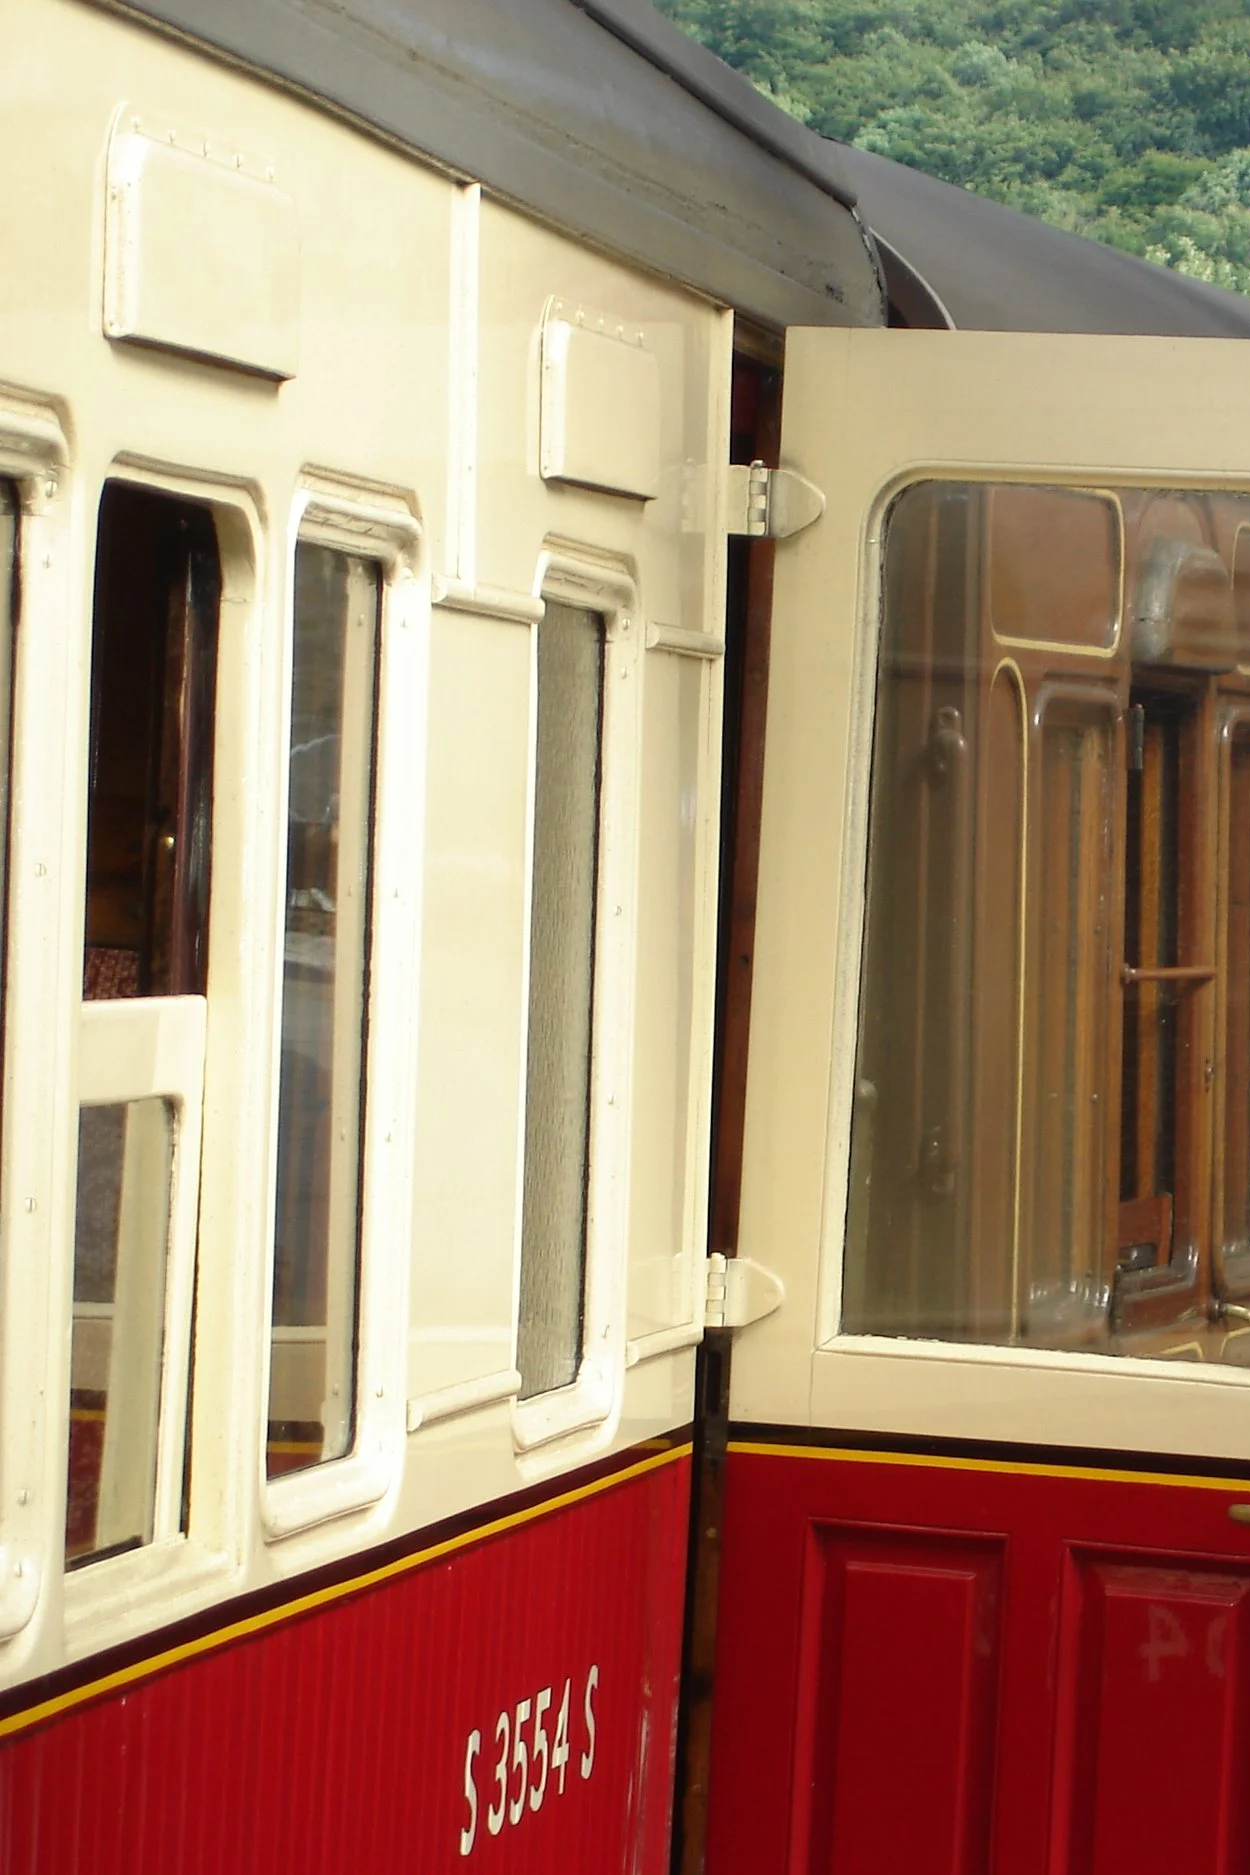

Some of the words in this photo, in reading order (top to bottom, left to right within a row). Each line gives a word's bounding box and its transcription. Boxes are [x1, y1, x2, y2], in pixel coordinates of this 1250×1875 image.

[459, 1729, 481, 1856] S
[487, 1677, 571, 1836] 3554
[580, 1664, 599, 1780] S
